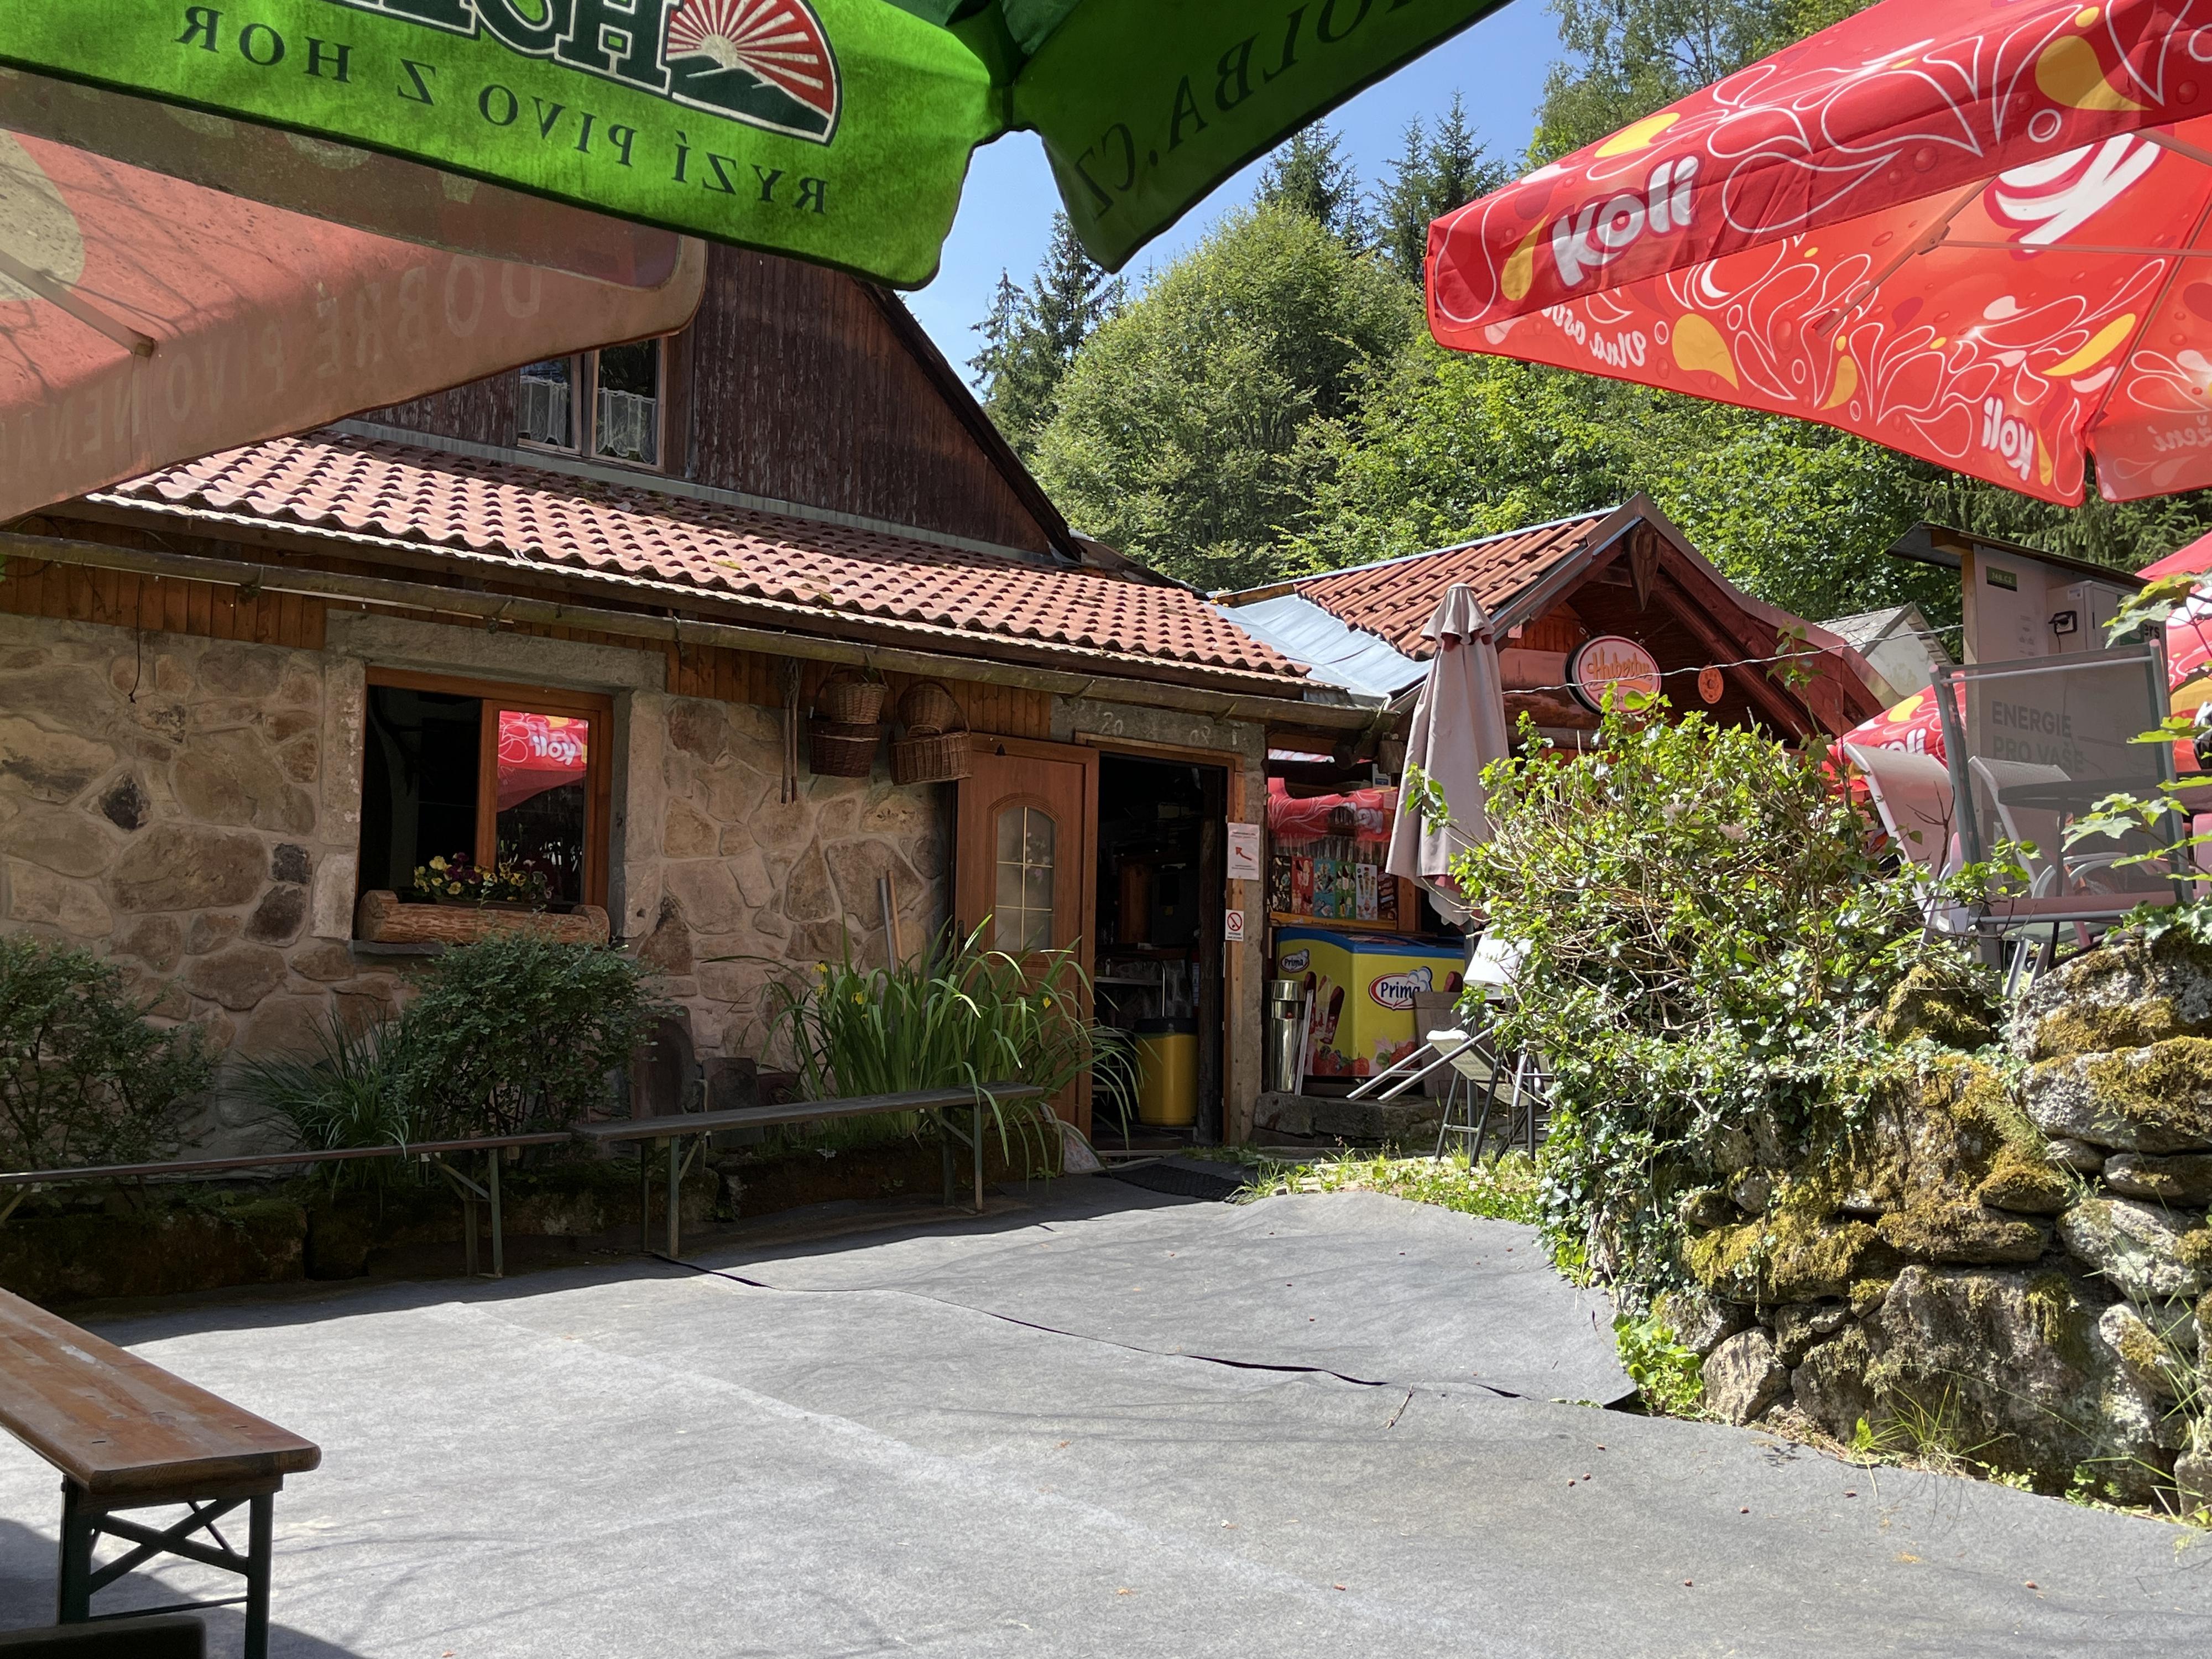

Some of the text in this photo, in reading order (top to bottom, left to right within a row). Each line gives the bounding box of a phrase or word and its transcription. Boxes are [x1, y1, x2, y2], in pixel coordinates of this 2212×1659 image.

[1992, 700, 2072, 738] ENERGIE
[1880, 728, 1927, 756] oli
[1994, 735, 2085, 774] PRO VAŠE
[1284, 958, 1304, 967] Prima
